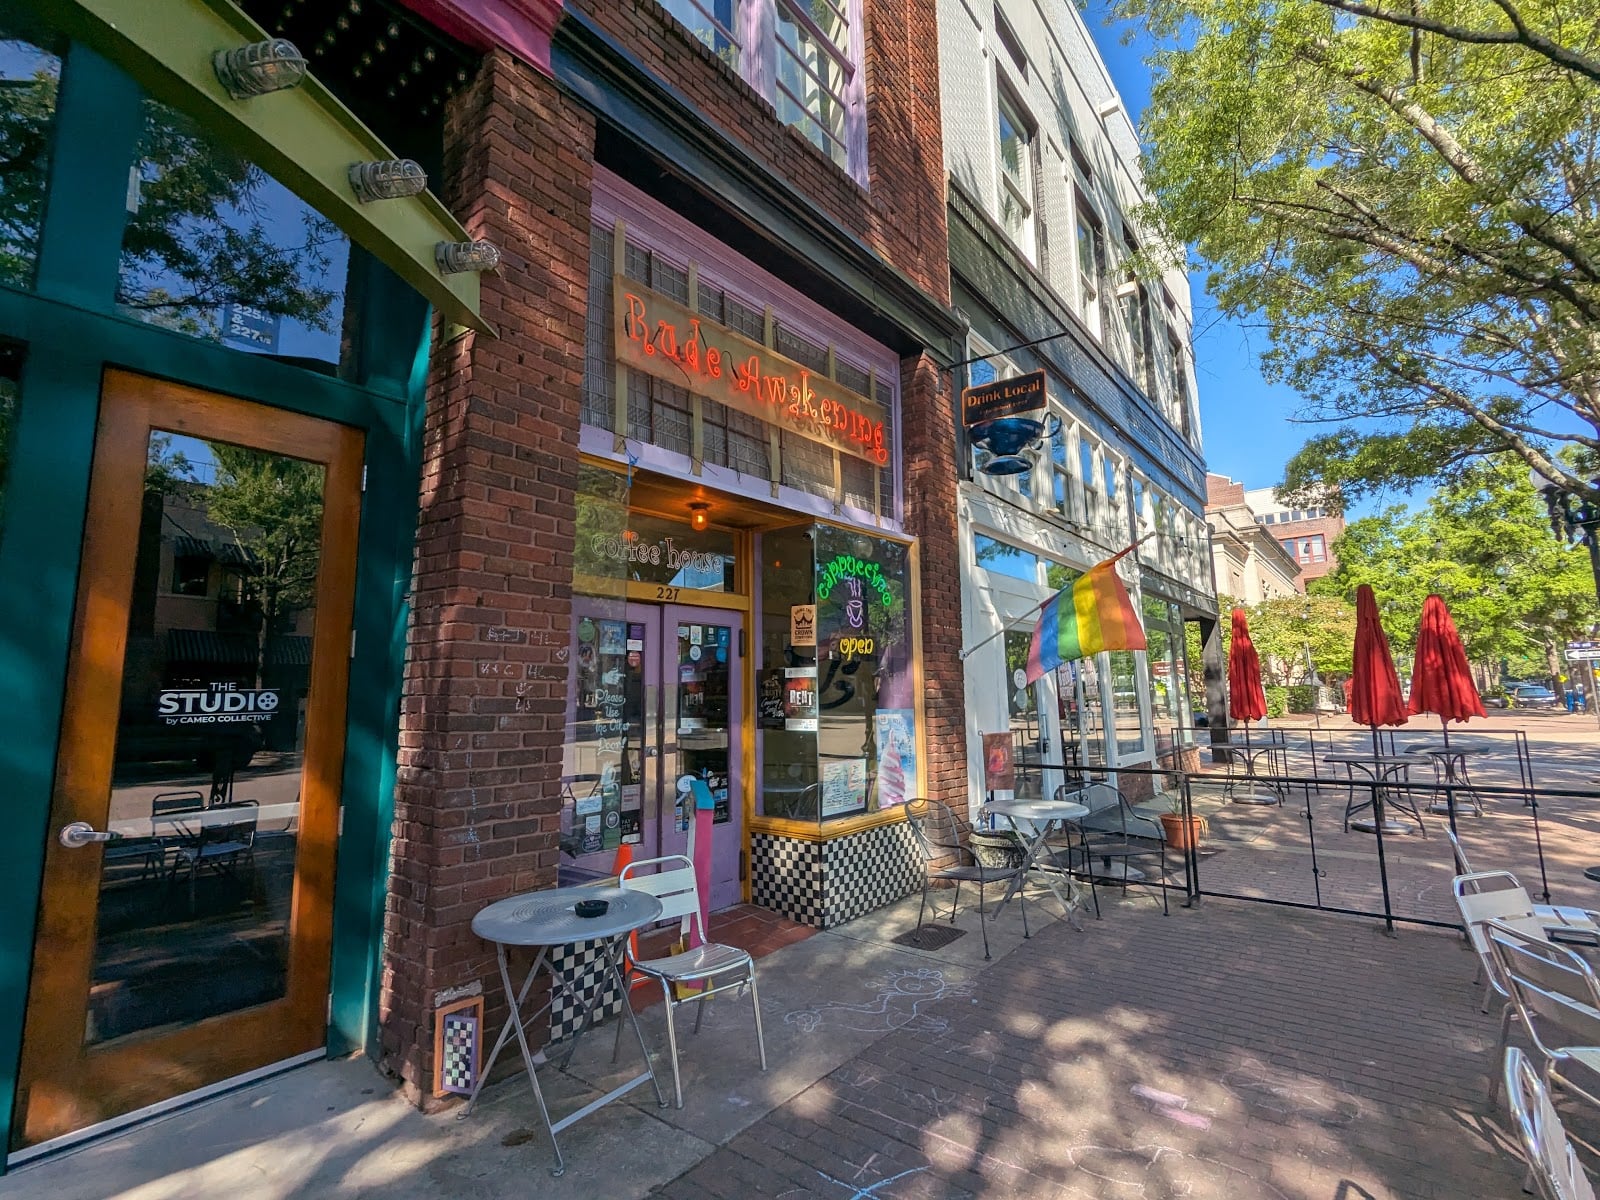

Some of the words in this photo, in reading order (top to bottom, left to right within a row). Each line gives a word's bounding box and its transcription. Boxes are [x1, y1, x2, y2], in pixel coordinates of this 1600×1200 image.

[231, 313, 244, 325] &
[232, 303, 261, 319] 225
[231, 324, 260, 340] 227
[624, 293, 721, 378] Rude
[739, 355, 888, 463] Awakening
[967, 390, 1001, 407] Drink
[1004, 379, 1040, 398] Local
[591, 529, 661, 566] coffee
[664, 537, 721, 575] house
[656, 586, 680, 602] 227
[840, 637, 874, 662] open
[209, 682, 237, 691] THE
[158, 691, 279, 714] STUDIO
[595, 688, 626, 706] Please
[789, 689, 814, 706] RENT
[166, 717, 178, 726] by
[180, 715, 216, 724] CAMEO
[217, 714, 272, 723] COLLECTIVE
[605, 706, 620, 718] Use
